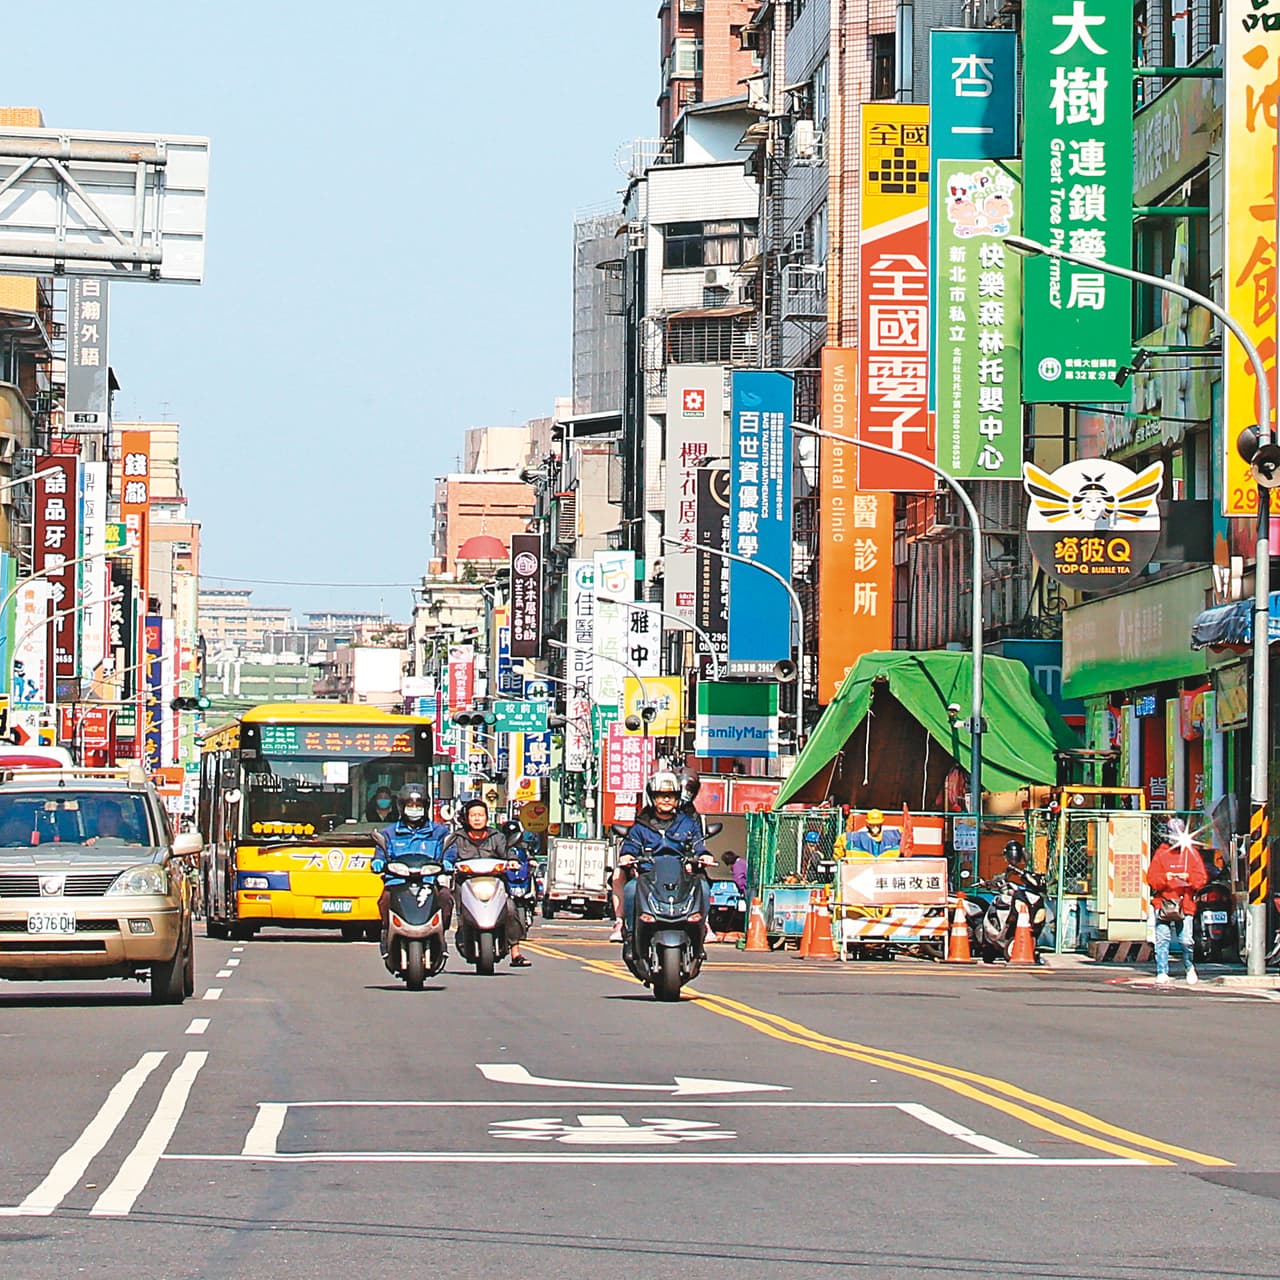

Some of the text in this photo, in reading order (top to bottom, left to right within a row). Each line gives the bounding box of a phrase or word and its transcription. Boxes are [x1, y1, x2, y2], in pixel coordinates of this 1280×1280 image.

[951, 54, 994, 134] 杏一
[1050, 1, 1109, 126] 大樹
[869, 122, 929, 146] 全國
[1048, 138, 1066, 310] Great Tree Phrmacy
[1067, 138, 1107, 310] 連鎖藥局
[949, 246, 967, 341] 新北市私立
[832, 364, 845, 430] wisdom
[867, 253, 928, 451] 全國電子
[977, 242, 1005, 470] 快樂森林托嬰中心
[738, 411, 760, 558] 百世資優數學
[831, 497, 844, 543] clinic
[700, 725, 776, 741] FamilyMart
[874, 875, 942, 892] 車輛改道
